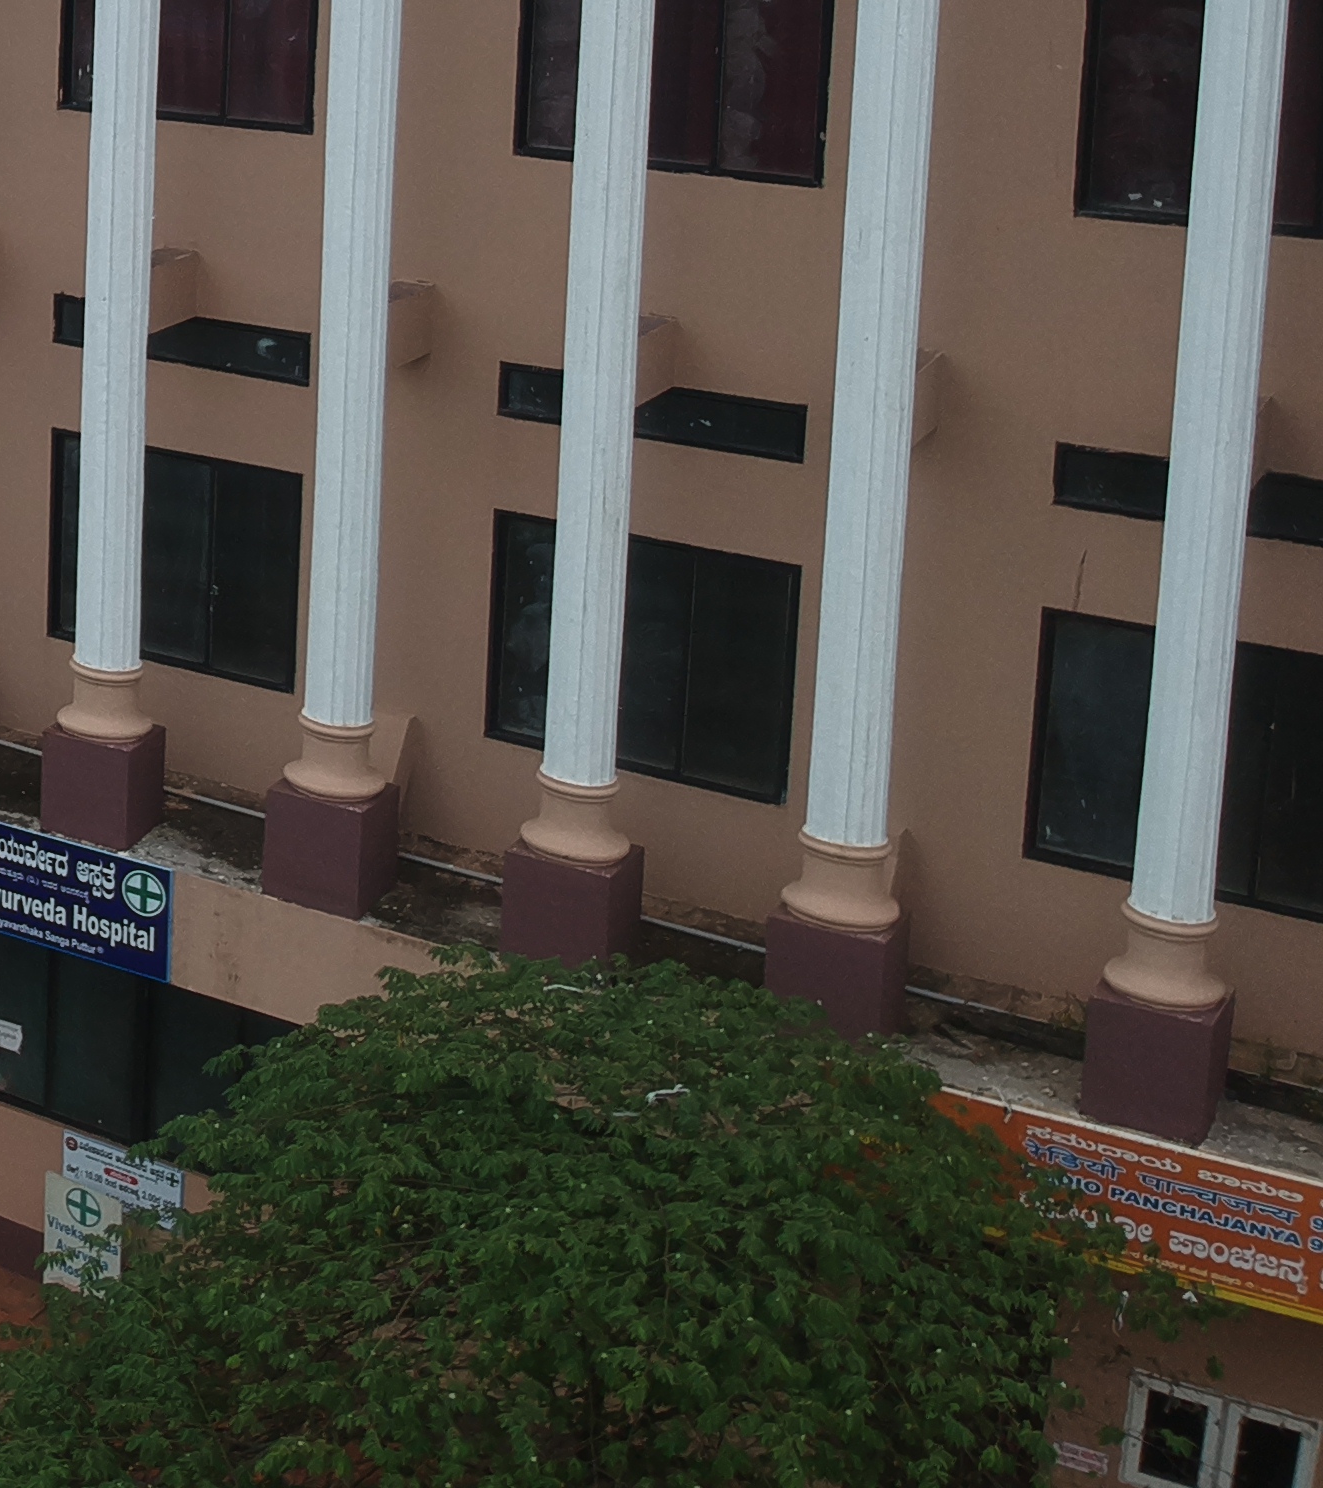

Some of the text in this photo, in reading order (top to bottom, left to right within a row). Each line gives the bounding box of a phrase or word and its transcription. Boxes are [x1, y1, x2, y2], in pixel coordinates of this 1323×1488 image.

[75, 859, 117, 900] ಆಸ್ಪತ್ರೆ
[45, 930, 70, 949] Sanga
[71, 937, 96, 954] Puttur
[74, 904, 155, 953] Hospital
[1022, 1137, 1126, 1181] रेडियो
[1025, 1124, 1182, 1173] ಸಮುದಾಯ
[1108, 1185, 1303, 1250] PANCHAJANYA
[1169, 1229, 1308, 1296] ಪಾಂಚಜನ್ಯ
